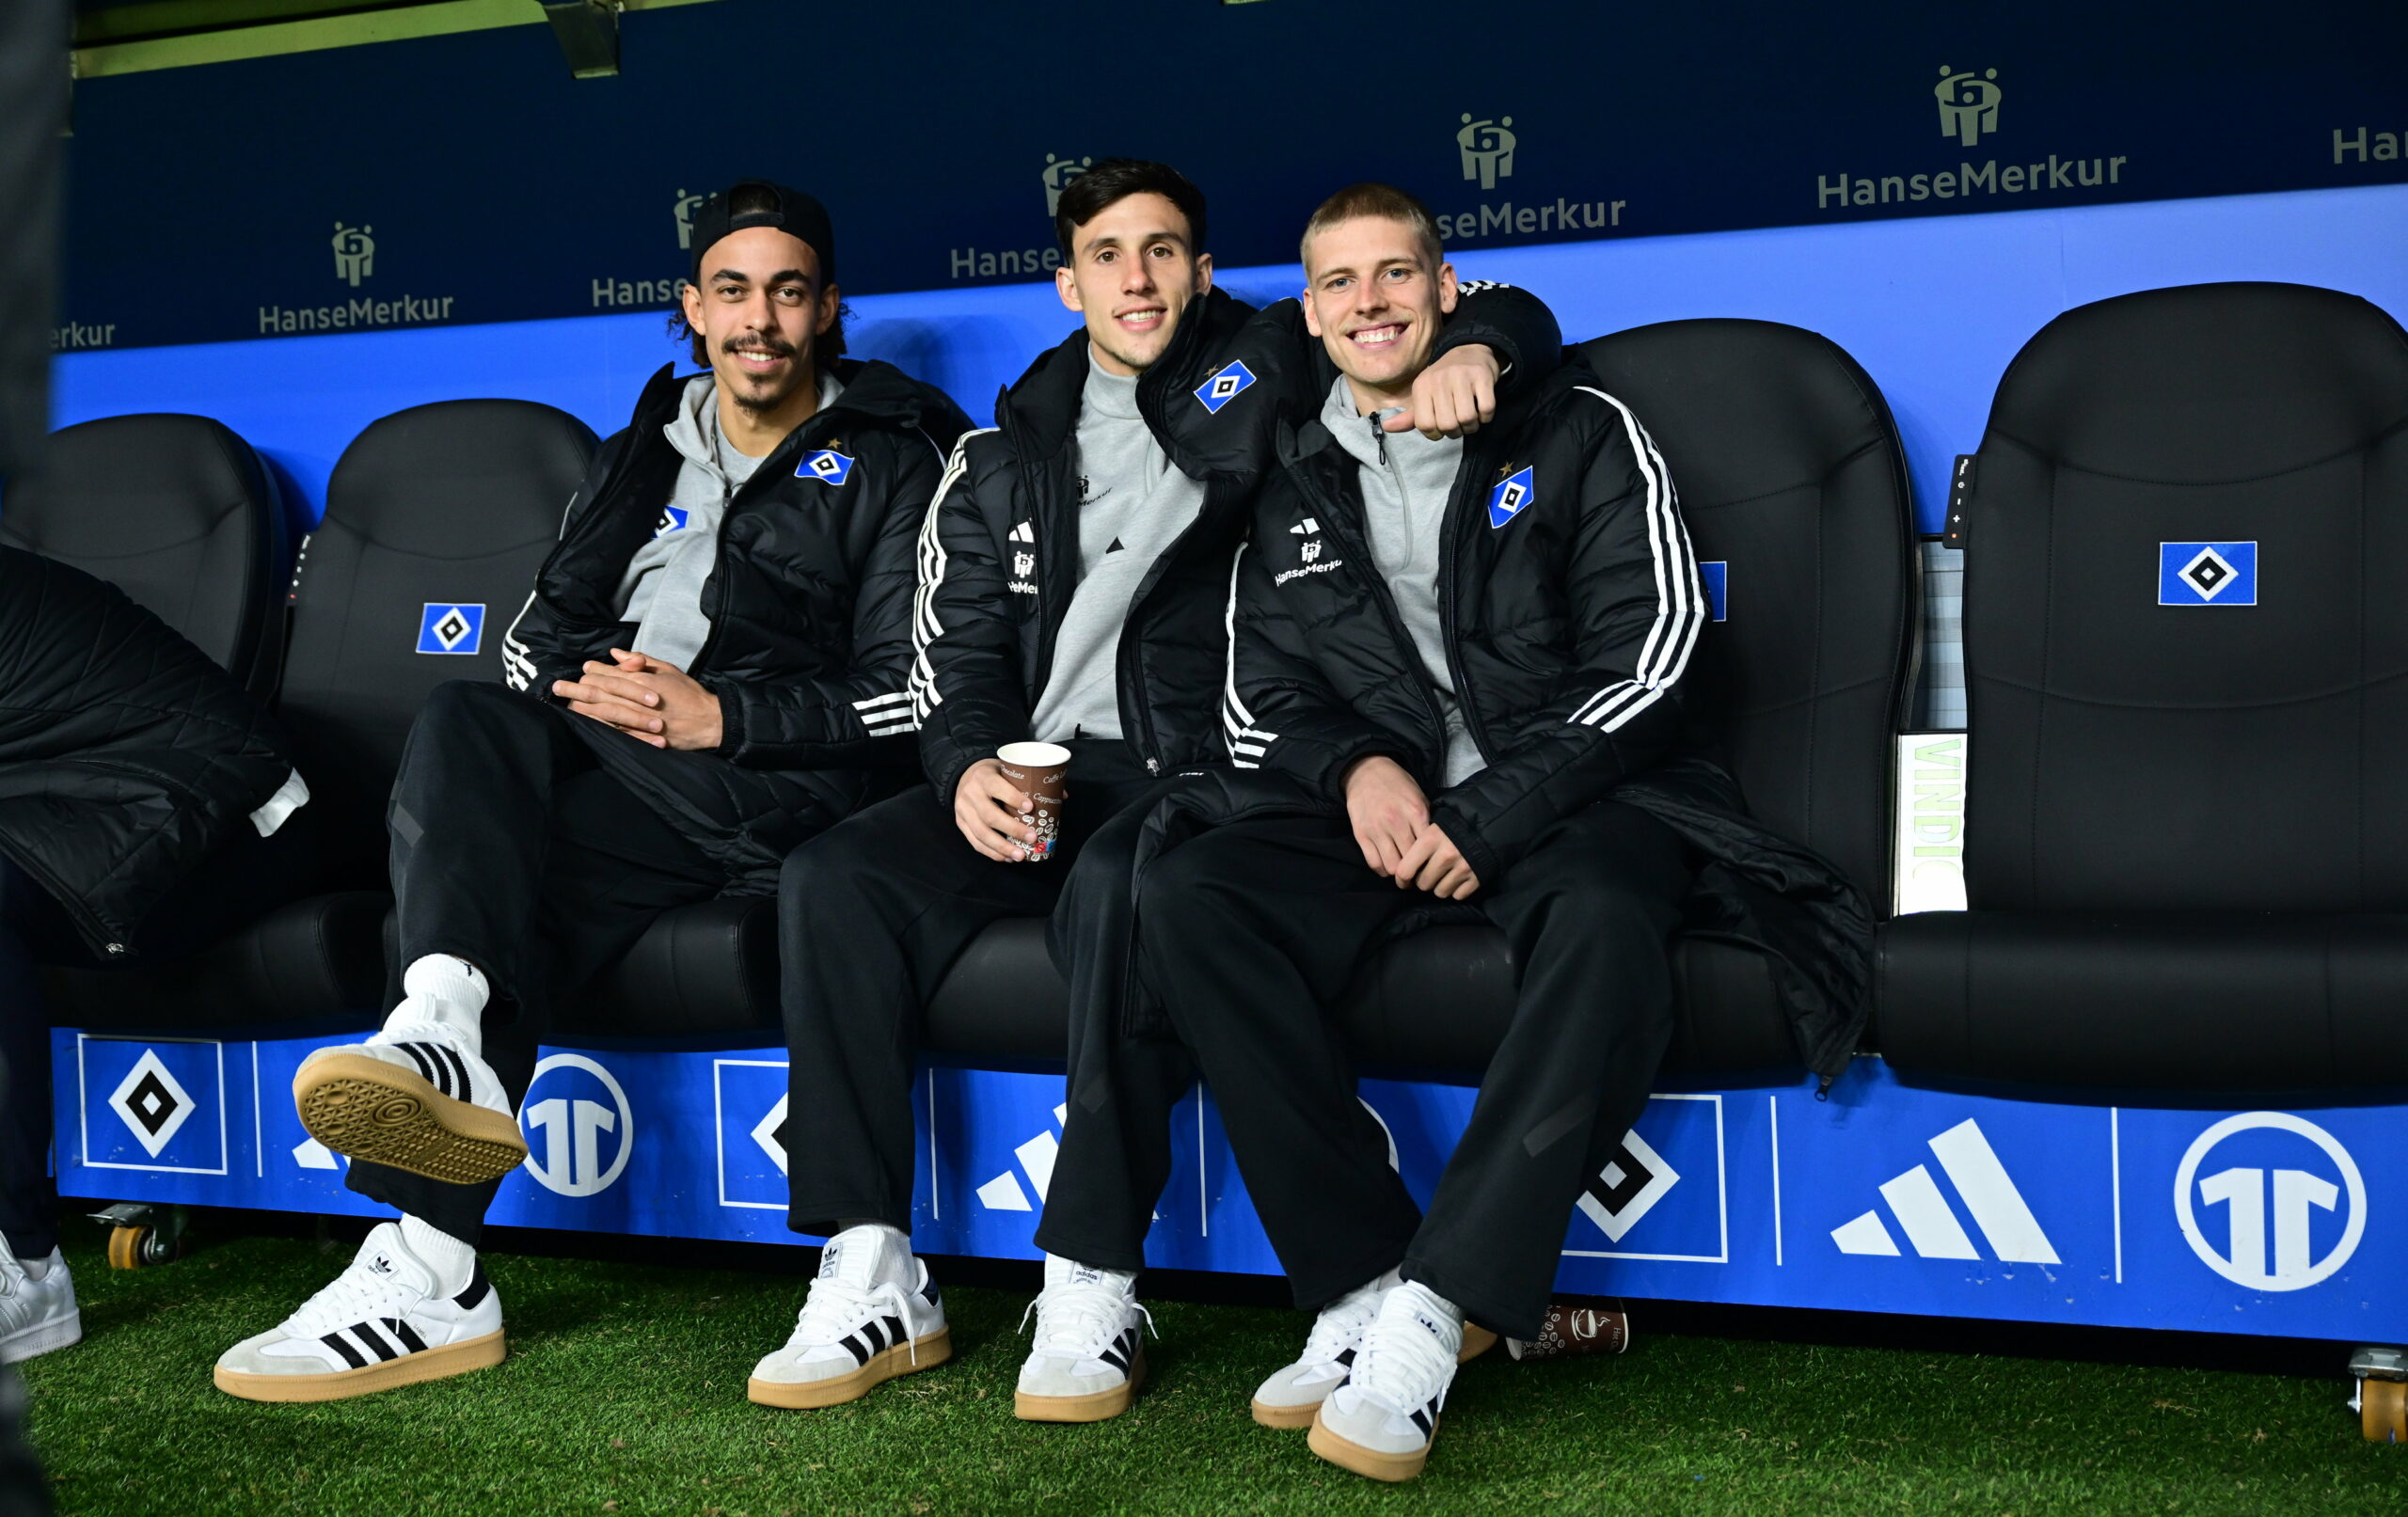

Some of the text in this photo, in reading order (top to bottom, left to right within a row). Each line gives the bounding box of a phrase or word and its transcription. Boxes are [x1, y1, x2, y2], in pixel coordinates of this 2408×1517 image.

[2333, 126, 2408, 166] Ha
[1817, 153, 2128, 209] HanseMerkur
[950, 246, 1069, 279] Hanse
[258, 292, 454, 335] HanseMerkur
